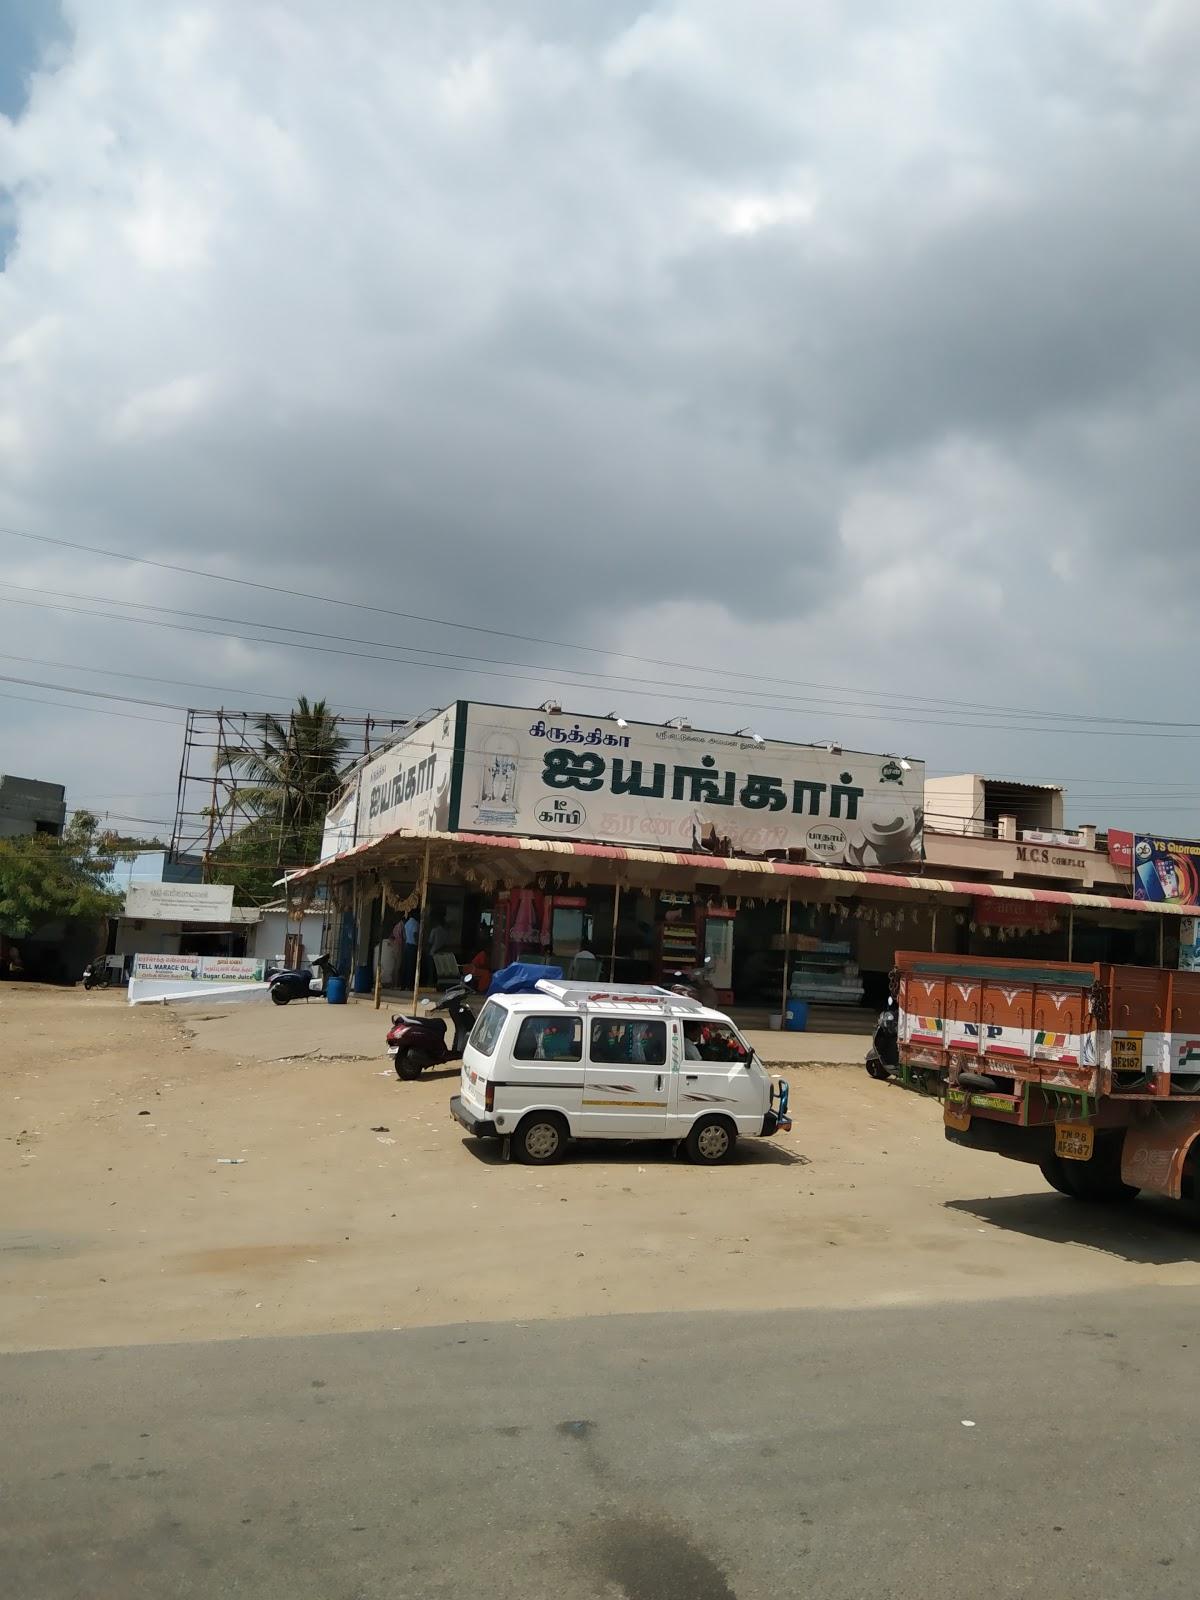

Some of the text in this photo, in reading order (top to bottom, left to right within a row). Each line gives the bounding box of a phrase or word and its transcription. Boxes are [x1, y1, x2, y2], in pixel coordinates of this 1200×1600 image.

[529, 720, 632, 748] கிருத்திகா
[369, 741, 437, 819] ஐயங்கார்
[541, 747, 864, 821] ஐயங்கார்
[538, 809, 581, 825] காபி
[808, 832, 845, 843] பாதாம்
[813, 842, 837, 851] பால்
[1152, 840, 1166, 852] YS
[180, 964, 191, 972] OIL
[202, 973, 220, 981] Sugar
[1114, 1040, 1127, 1051] TN
[1061, 1129, 1073, 1140] TN
